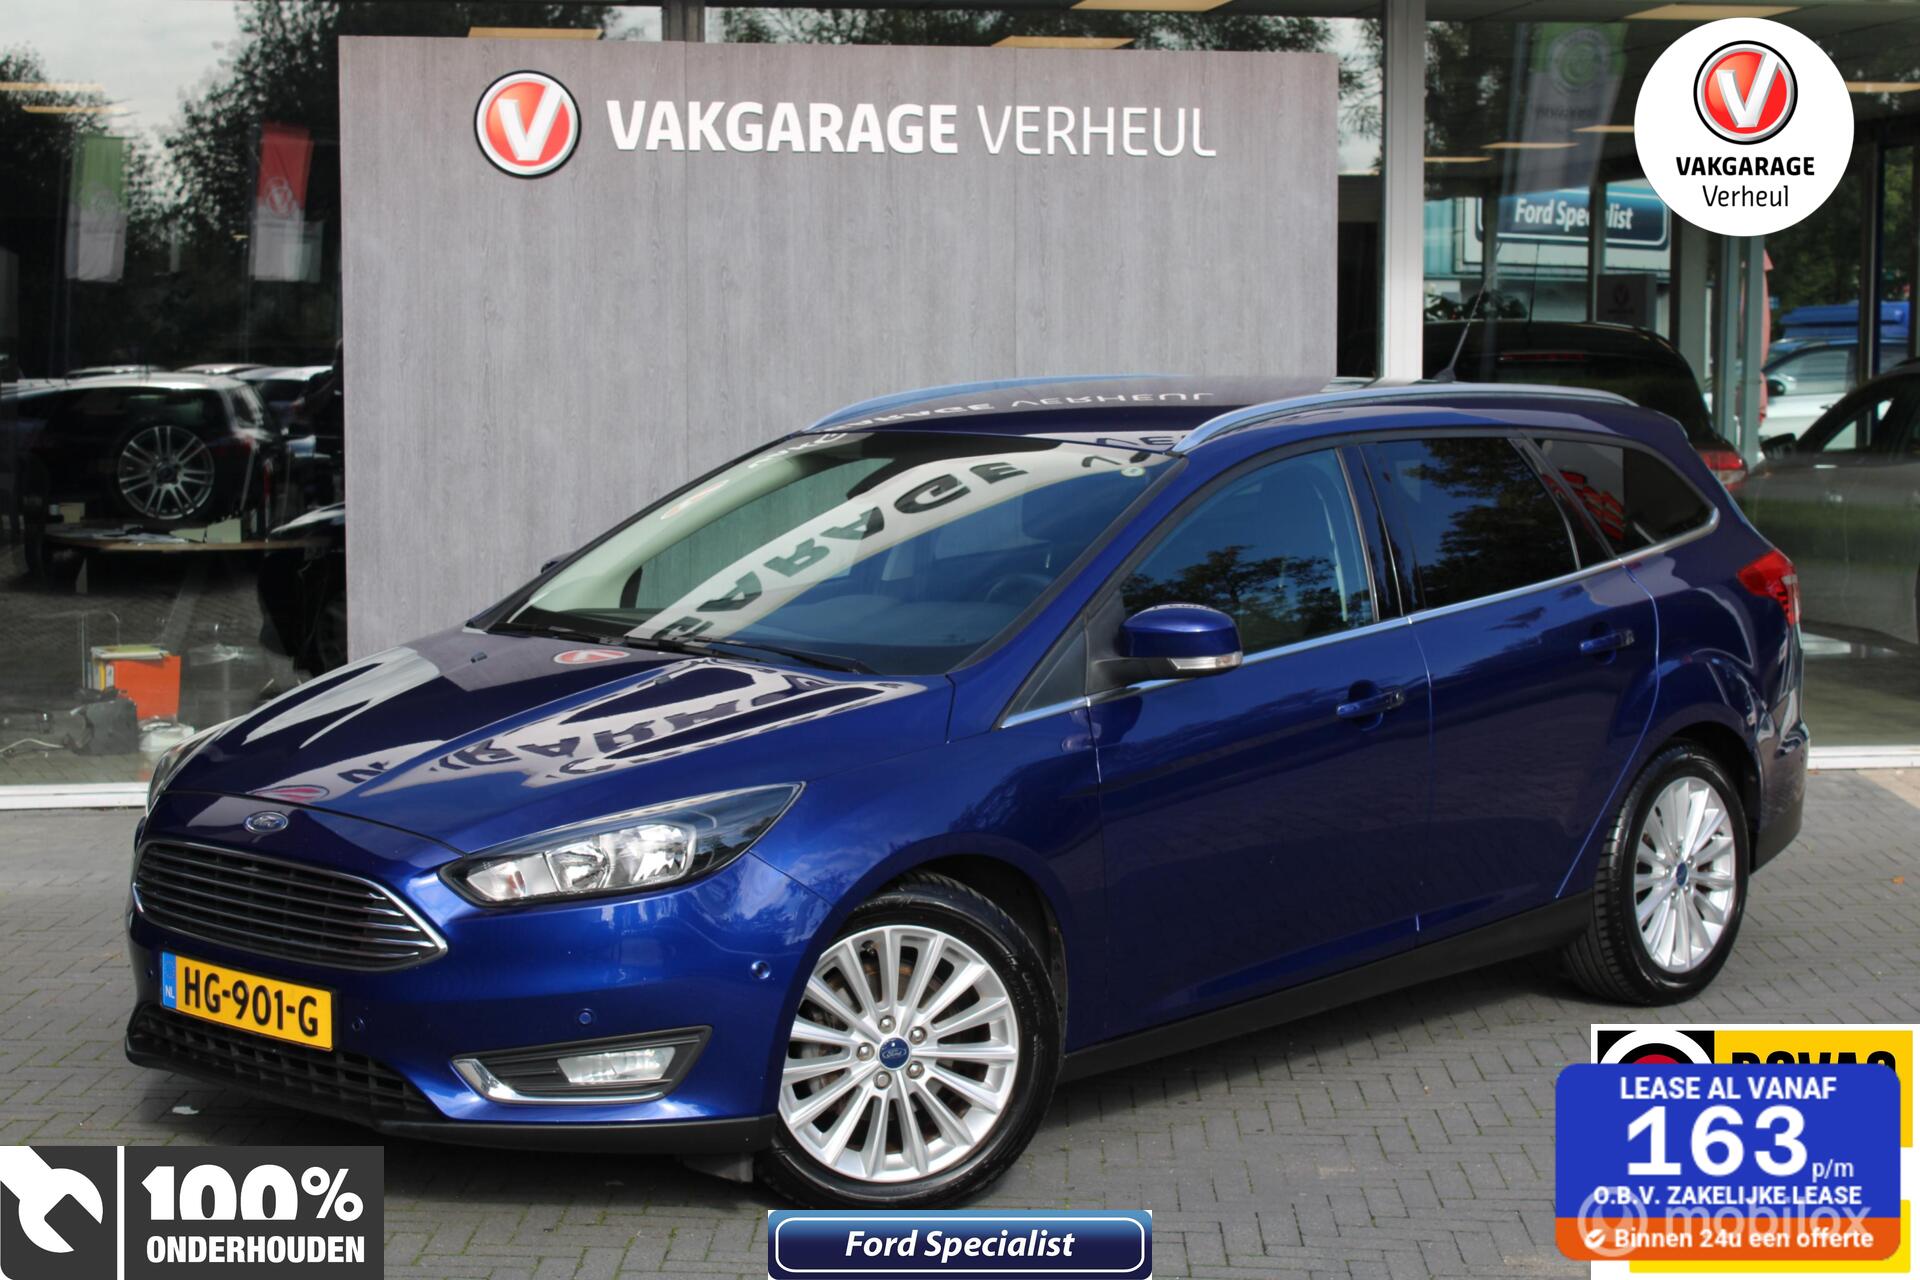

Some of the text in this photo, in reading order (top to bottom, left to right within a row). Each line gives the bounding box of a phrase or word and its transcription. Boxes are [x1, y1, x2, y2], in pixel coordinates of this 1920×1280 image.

[606, 100, 1217, 157] VAKGARAGE VERHEUL
[1514, 198, 1633, 232] Ford Spelist
[165, 985, 175, 999] NL
[184, 966, 319, 1037] HG-901-G
